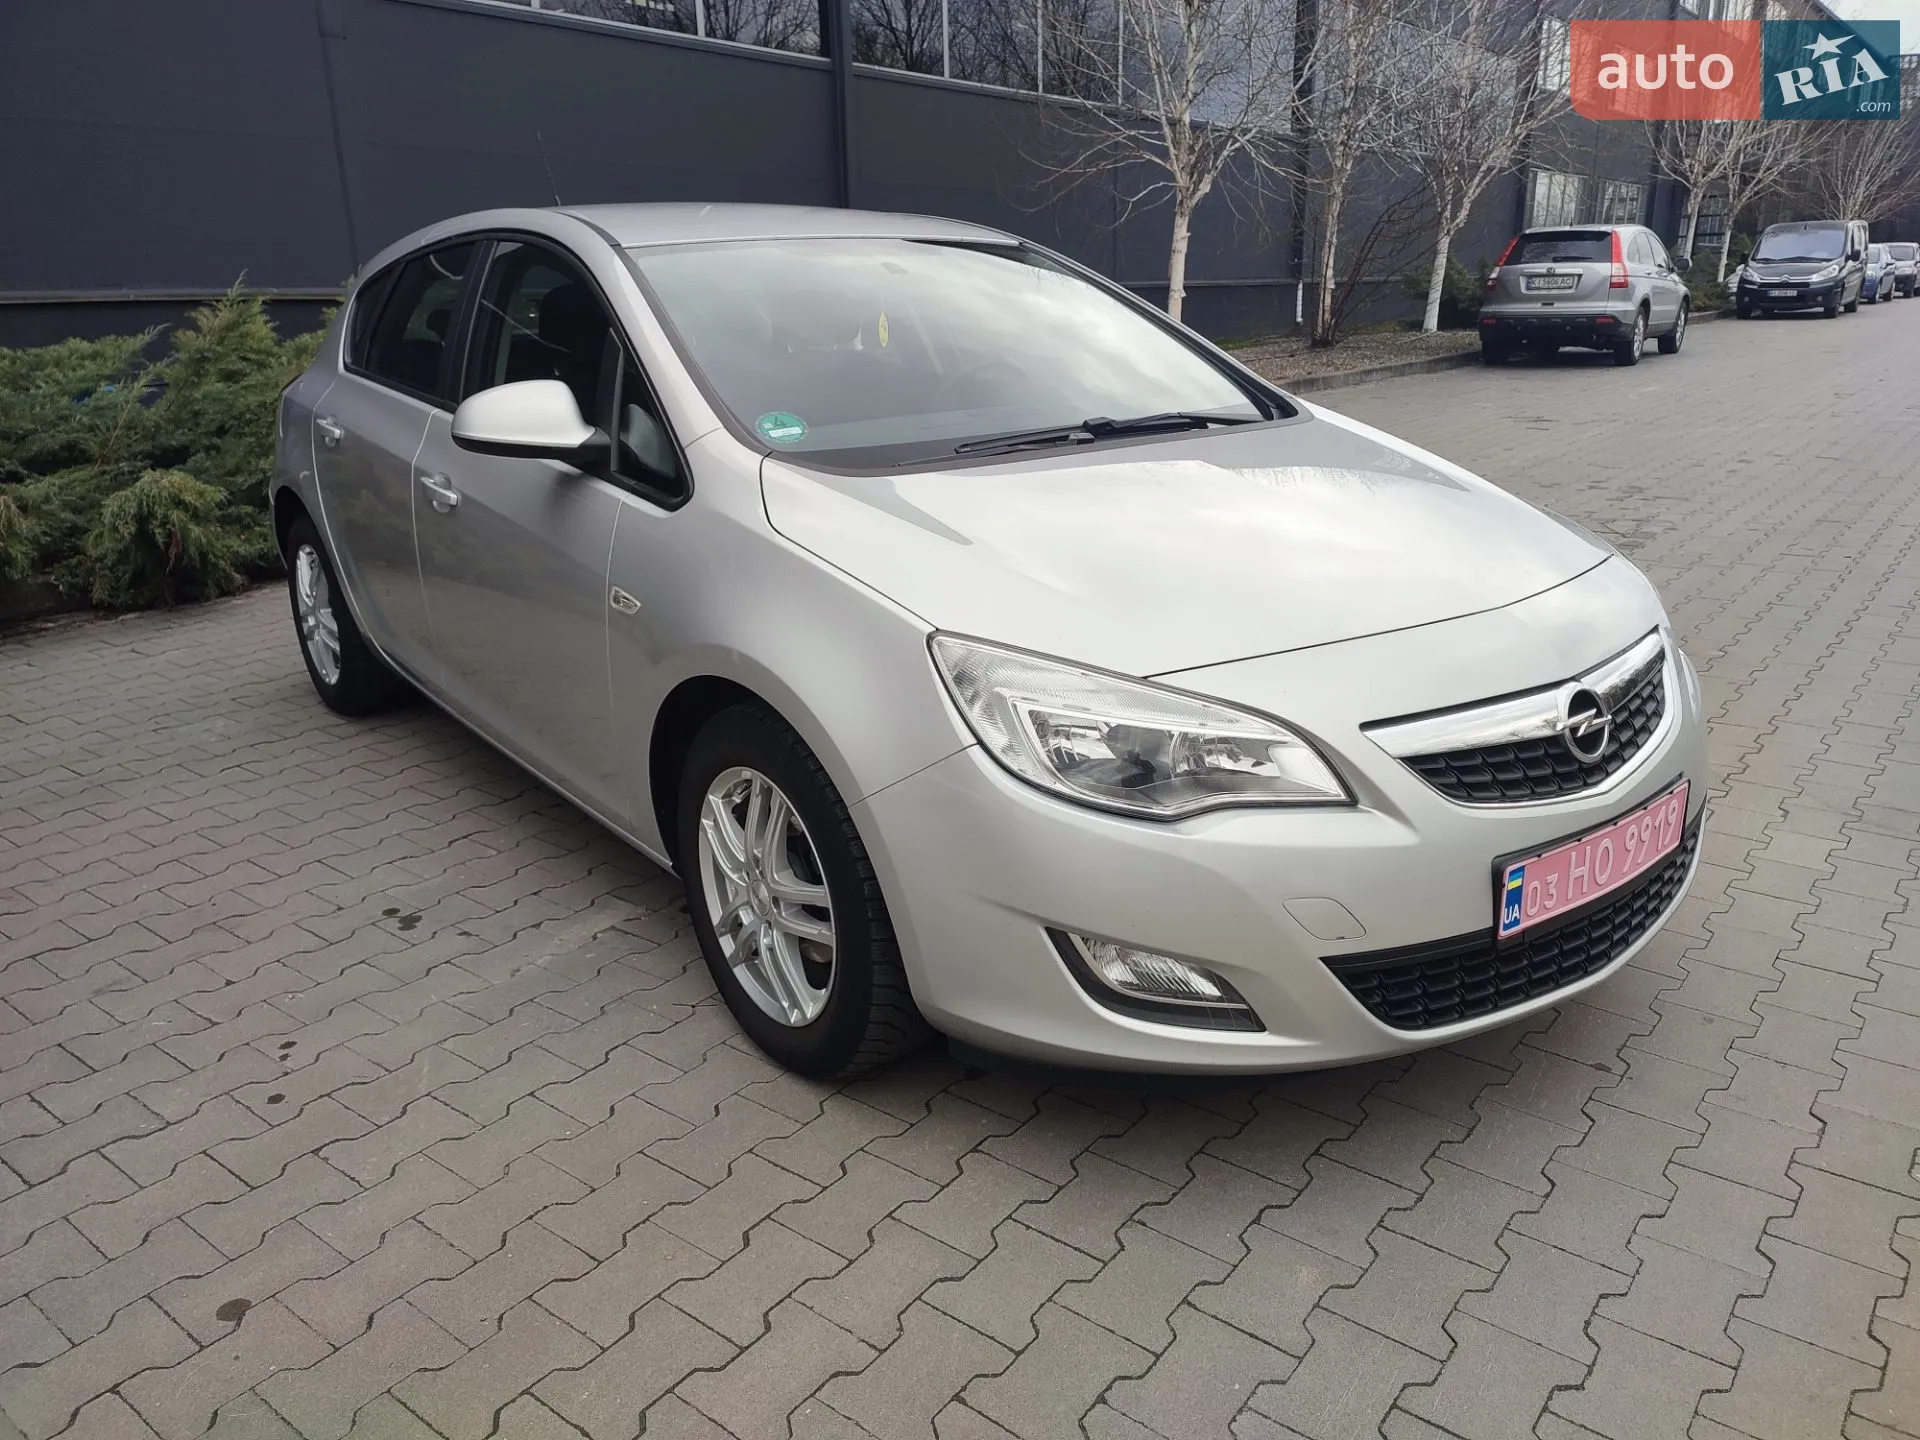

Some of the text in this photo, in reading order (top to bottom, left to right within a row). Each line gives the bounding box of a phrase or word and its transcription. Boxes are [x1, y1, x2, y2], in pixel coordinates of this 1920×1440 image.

[1526, 799, 1679, 916] 03 HO 9919
[1504, 903, 1520, 925] UA
